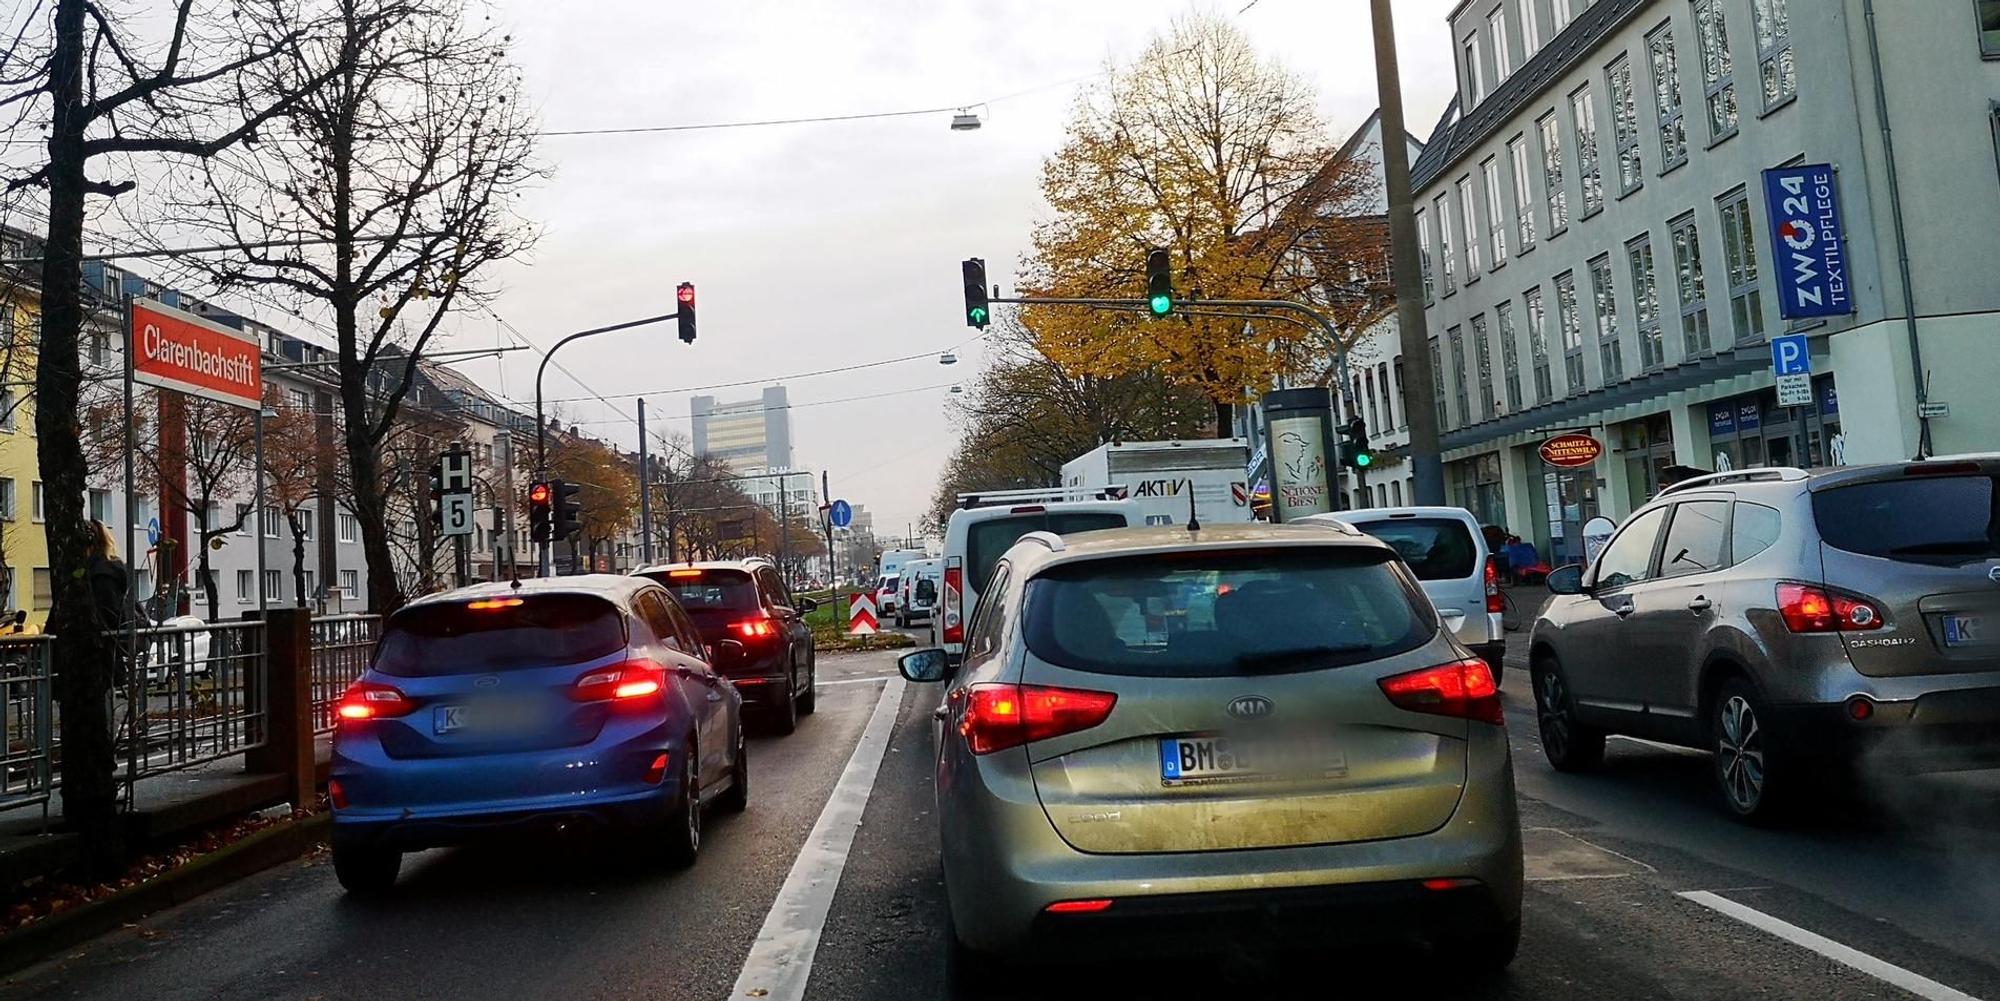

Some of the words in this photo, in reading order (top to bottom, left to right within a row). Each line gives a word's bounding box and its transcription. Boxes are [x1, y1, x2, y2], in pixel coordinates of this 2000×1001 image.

[1814, 173, 1846, 306] TEXTILPFLEGE
[143, 324, 254, 387] Clarenbachstift
[1780, 341, 1799, 373] P
[1551, 440, 1584, 449] SCHMITZ
[442, 455, 471, 490] H
[451, 500, 465, 528] 5
[1288, 497, 1318, 508] BIEST
[1958, 619, 1972, 640] K
[1234, 700, 1267, 715] KIA
